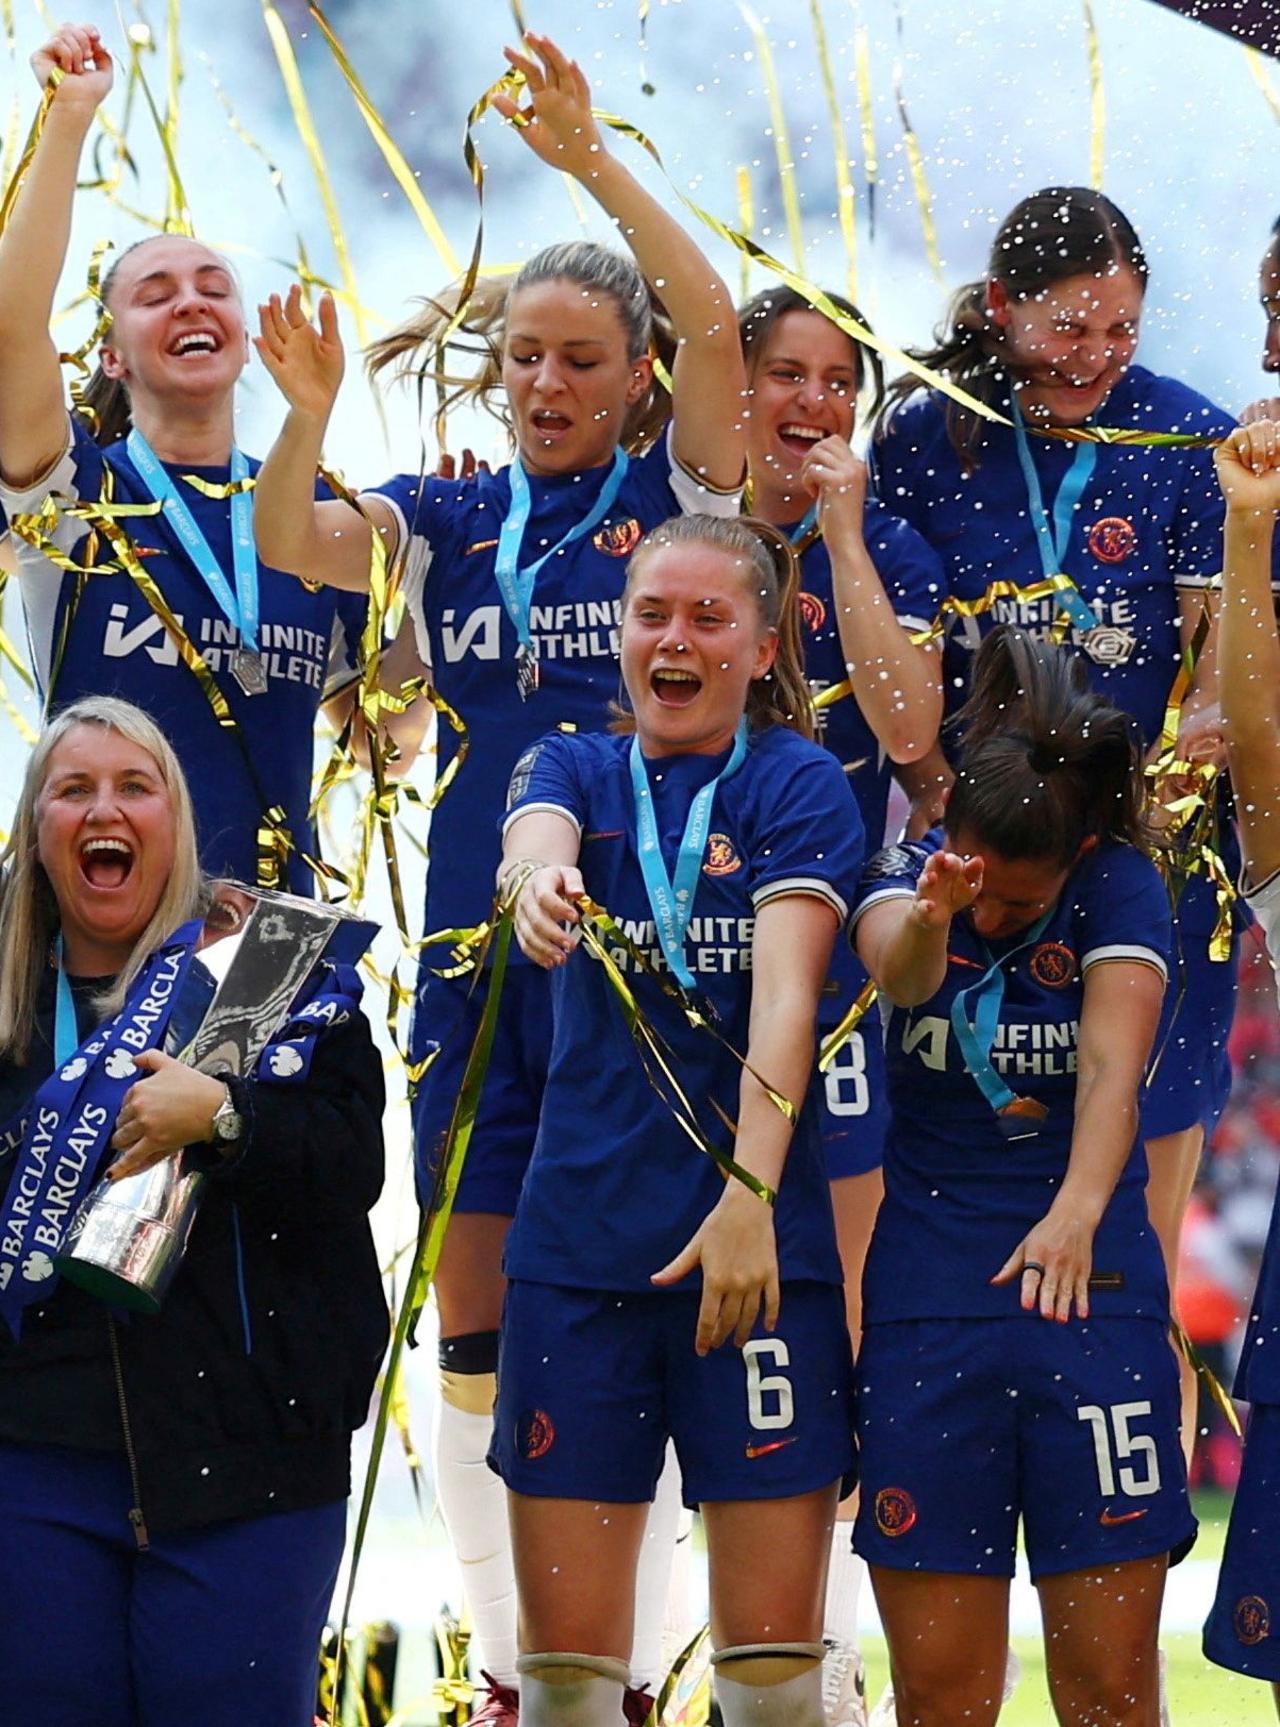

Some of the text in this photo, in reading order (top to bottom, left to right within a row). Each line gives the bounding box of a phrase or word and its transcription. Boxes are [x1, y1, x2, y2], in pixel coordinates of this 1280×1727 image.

[200, 617, 325, 662] ININITE
[1, 1107, 60, 1258] BARCLAYS
[34, 1103, 108, 1249] BARCLAYS
[742, 1338, 794, 1430] 6
[1077, 1400, 1161, 1497] 15
